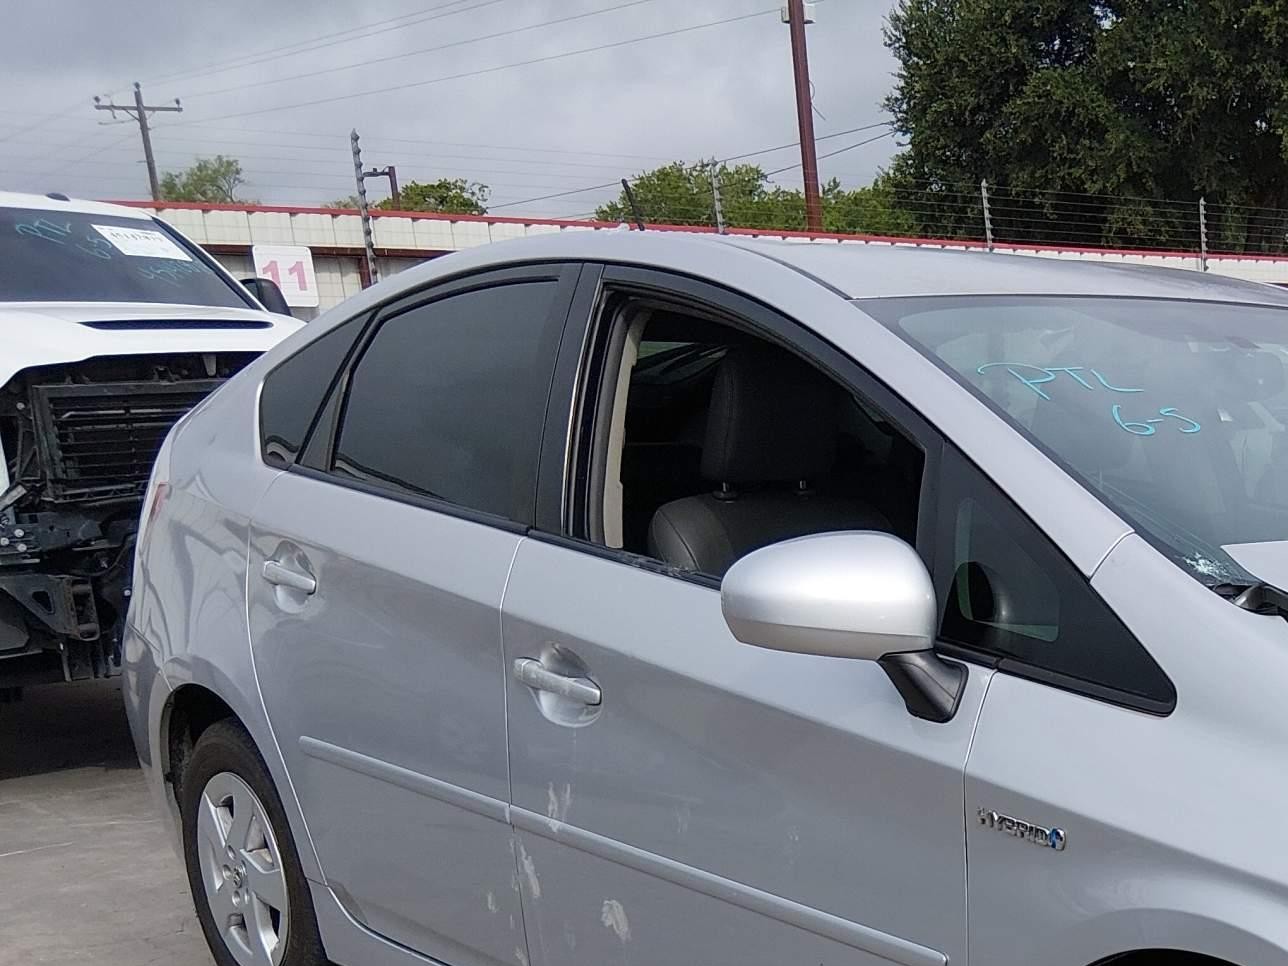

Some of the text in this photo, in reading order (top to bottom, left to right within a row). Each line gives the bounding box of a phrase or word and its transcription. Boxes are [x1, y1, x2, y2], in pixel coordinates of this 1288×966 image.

[262, 260, 308, 291] 11
[977, 362, 1145, 400] PTL
[976, 807, 1051, 847] HYBRID
